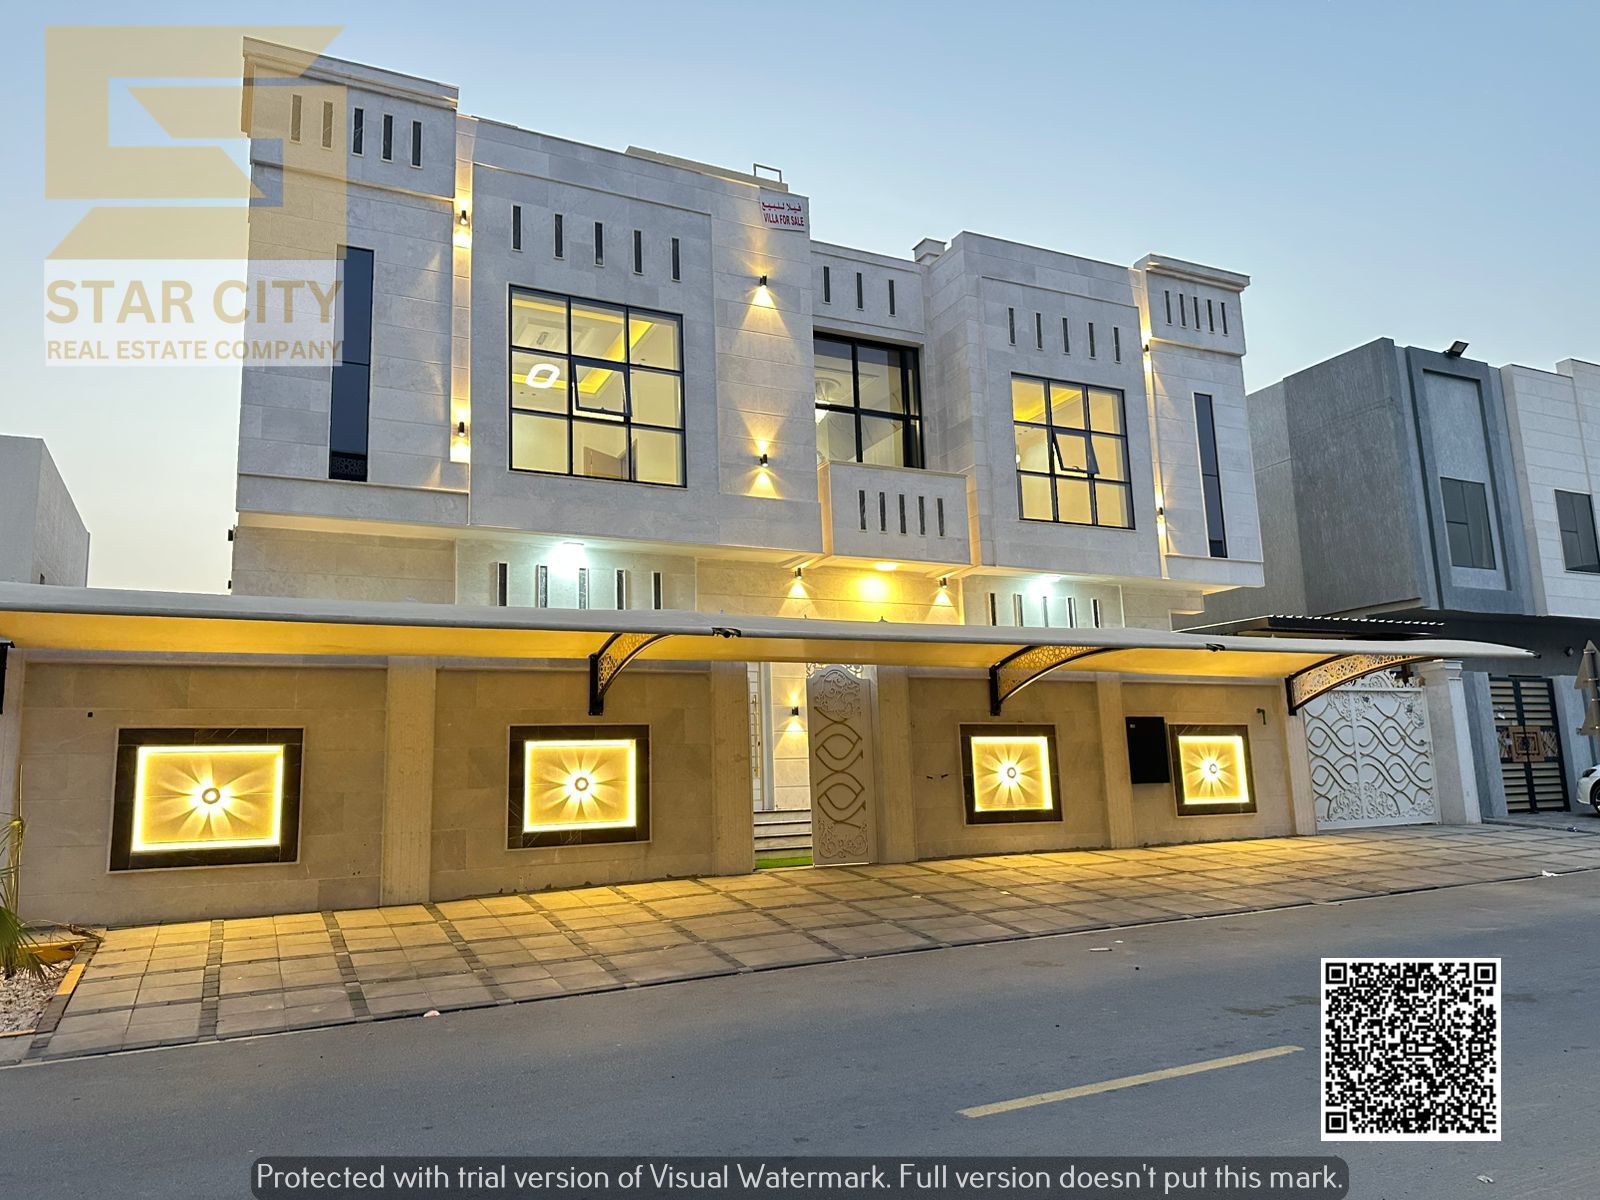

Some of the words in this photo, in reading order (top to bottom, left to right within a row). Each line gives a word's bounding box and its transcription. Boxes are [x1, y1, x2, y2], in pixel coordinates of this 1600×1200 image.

[762, 202, 784, 211] للبيع
[786, 202, 801, 213] فيلا
[763, 213, 779, 224] VILLA
[779, 214, 790, 225] FOR
[791, 216, 804, 227] SALE
